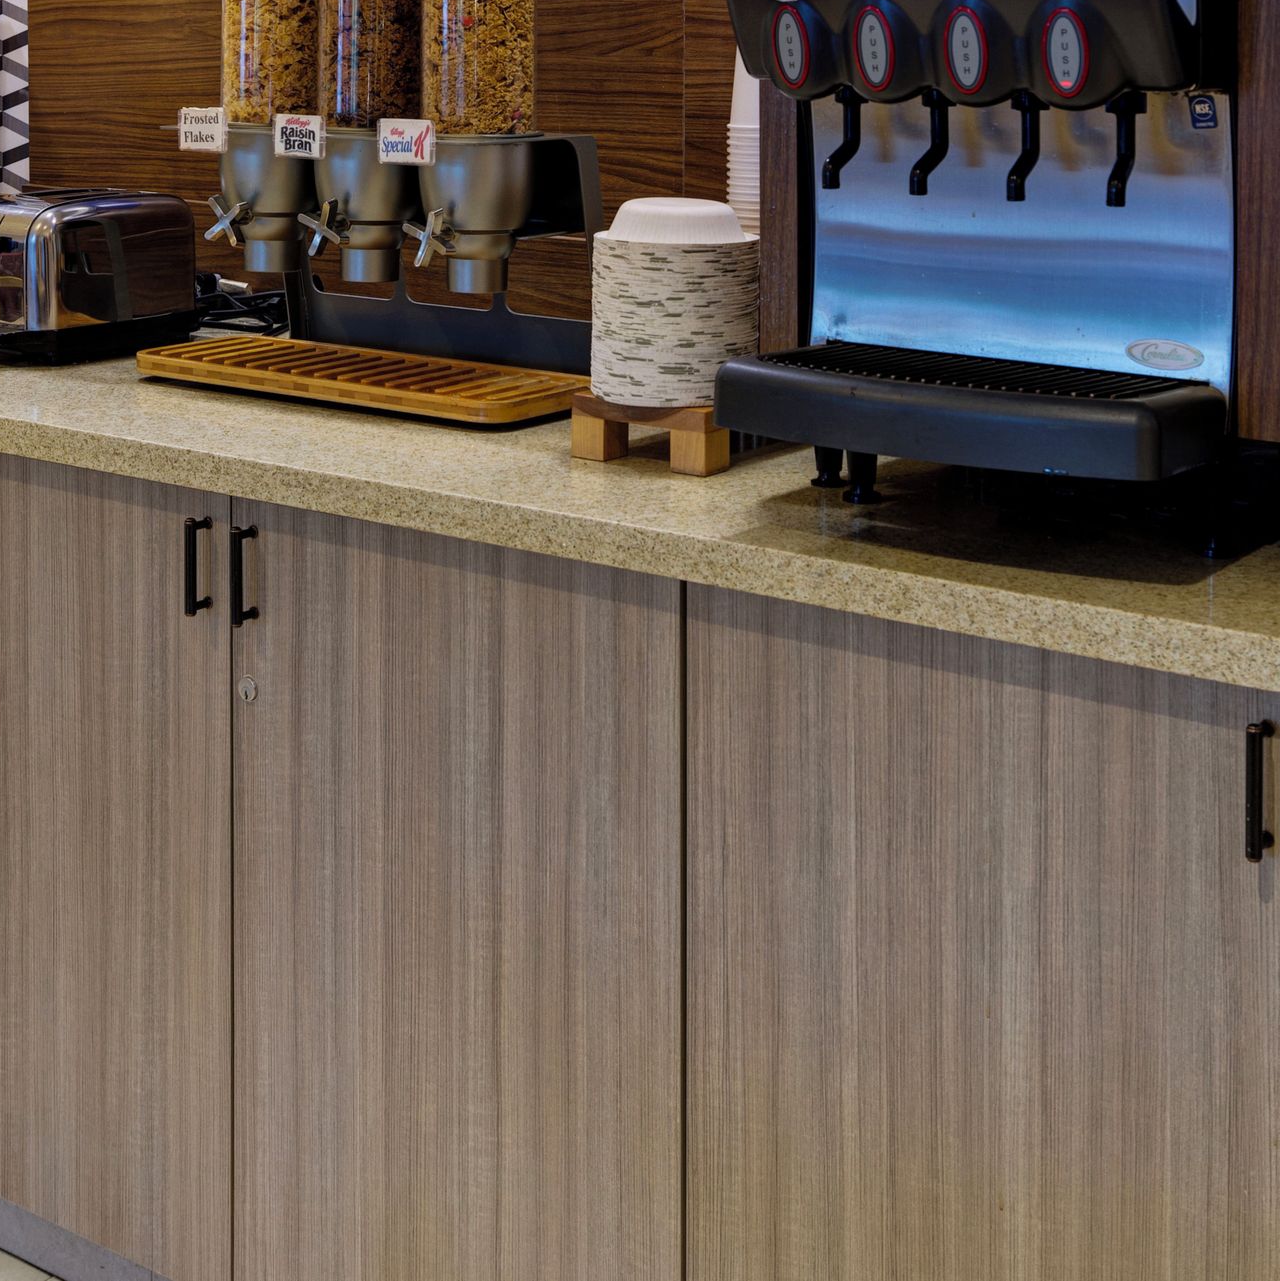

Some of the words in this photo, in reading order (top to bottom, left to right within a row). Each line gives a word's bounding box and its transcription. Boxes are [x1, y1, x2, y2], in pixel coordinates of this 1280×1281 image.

[785, 23, 795, 70] PUSH
[869, 25, 880, 73] PUSH
[961, 26, 971, 75] PUSH
[1061, 28, 1071, 79] PUSH
[183, 112, 219, 125] Frosted
[184, 130, 215, 143] Flakes
[280, 126, 316, 142] Raisin
[284, 138, 313, 152] Bran
[381, 136, 413, 157] Special
[414, 124, 430, 160] K
